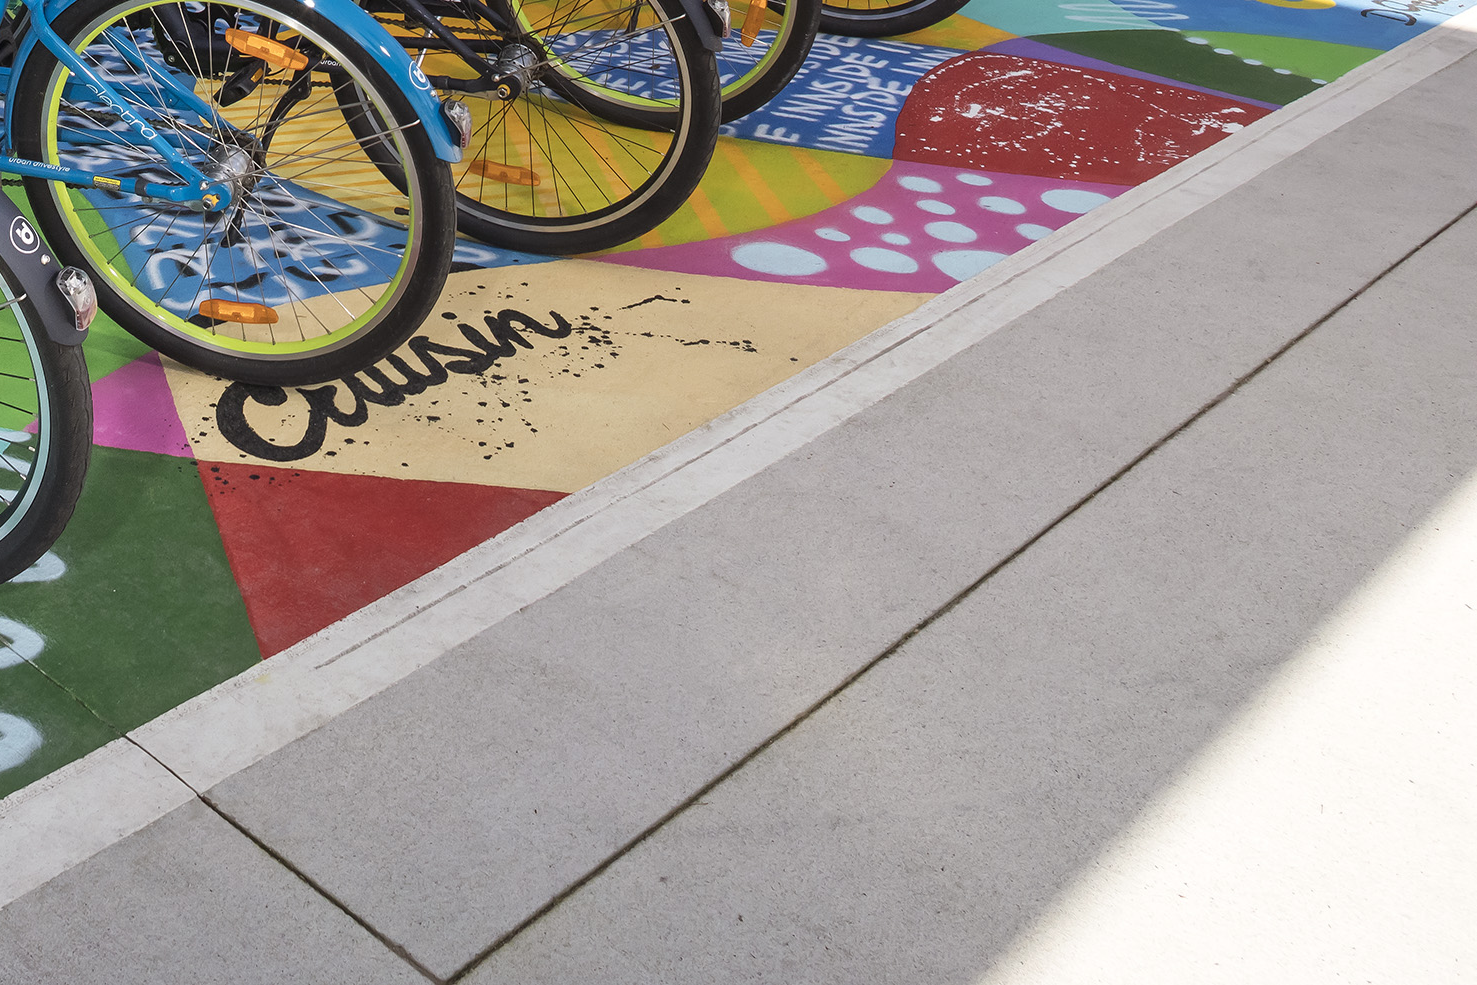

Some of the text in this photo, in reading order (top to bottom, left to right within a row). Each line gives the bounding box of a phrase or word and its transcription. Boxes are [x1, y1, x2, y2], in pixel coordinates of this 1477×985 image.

[86, 84, 158, 140] electra
[770, 52, 889, 122] INNSIDE
[814, 76, 913, 154] INNSIDE
[8, 157, 71, 172] urban drivestyle
[215, 309, 572, 462] Cruisin
